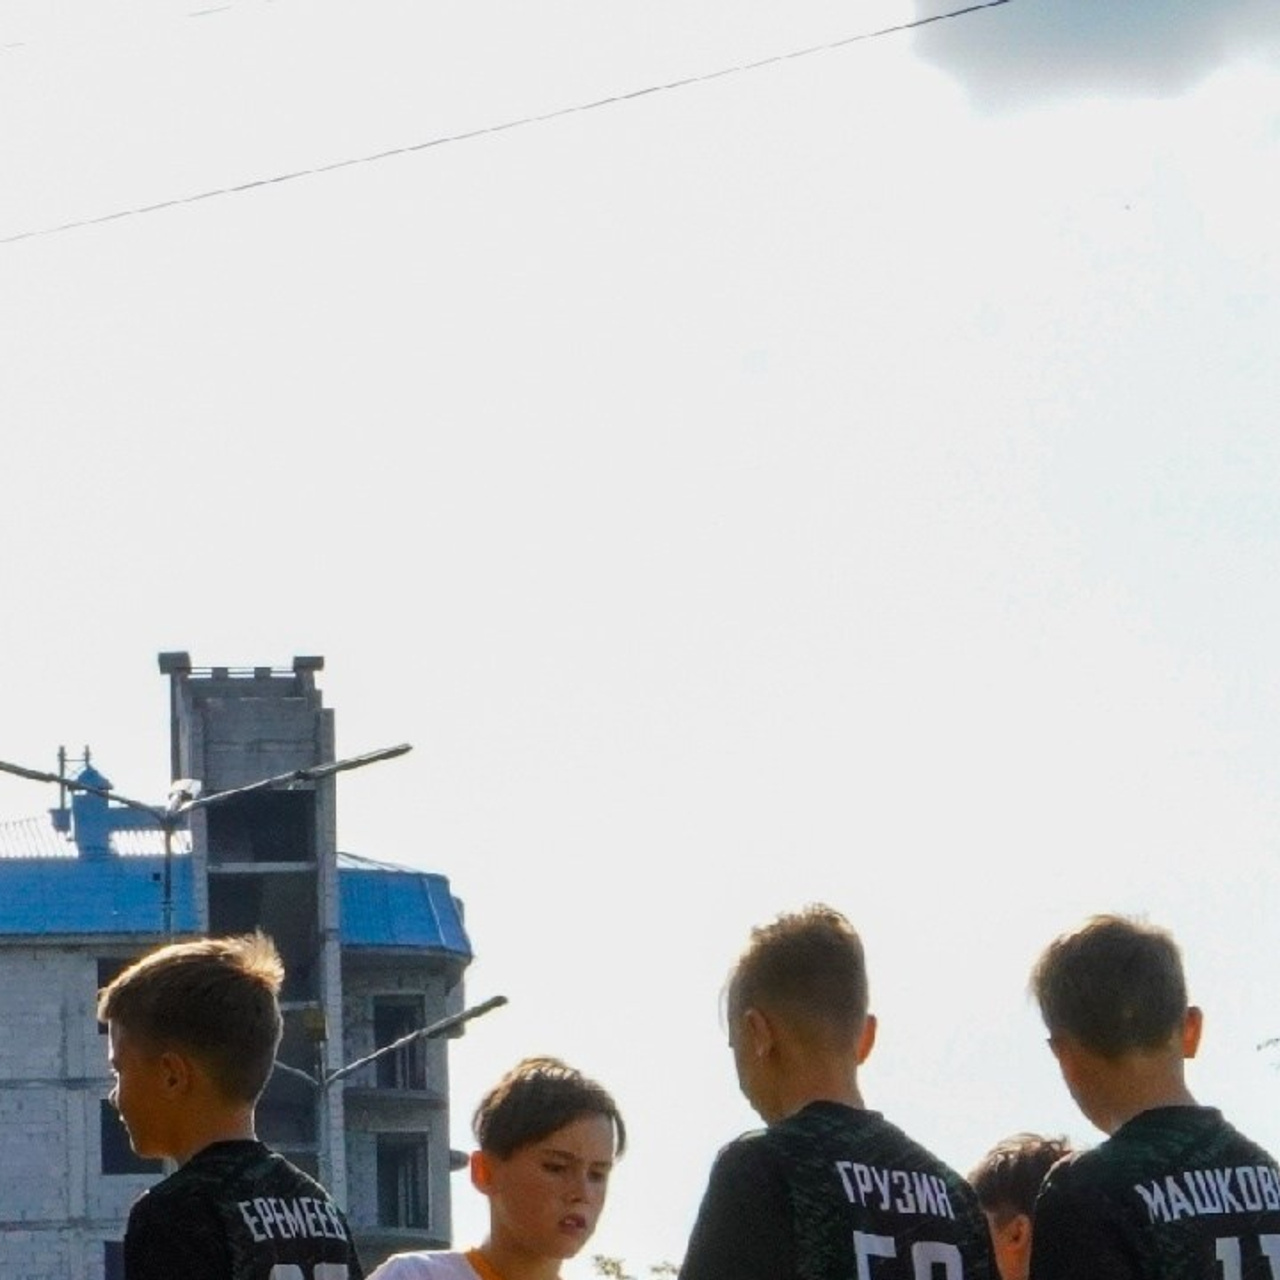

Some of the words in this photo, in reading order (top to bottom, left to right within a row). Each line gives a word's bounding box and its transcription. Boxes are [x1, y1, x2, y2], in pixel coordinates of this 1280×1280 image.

[835, 1160, 956, 1220] ГРУЗИН
[1134, 1166, 1280, 1224] МАШКОВ
[237, 1197, 348, 1243] ЕРЕМЕЕВ
